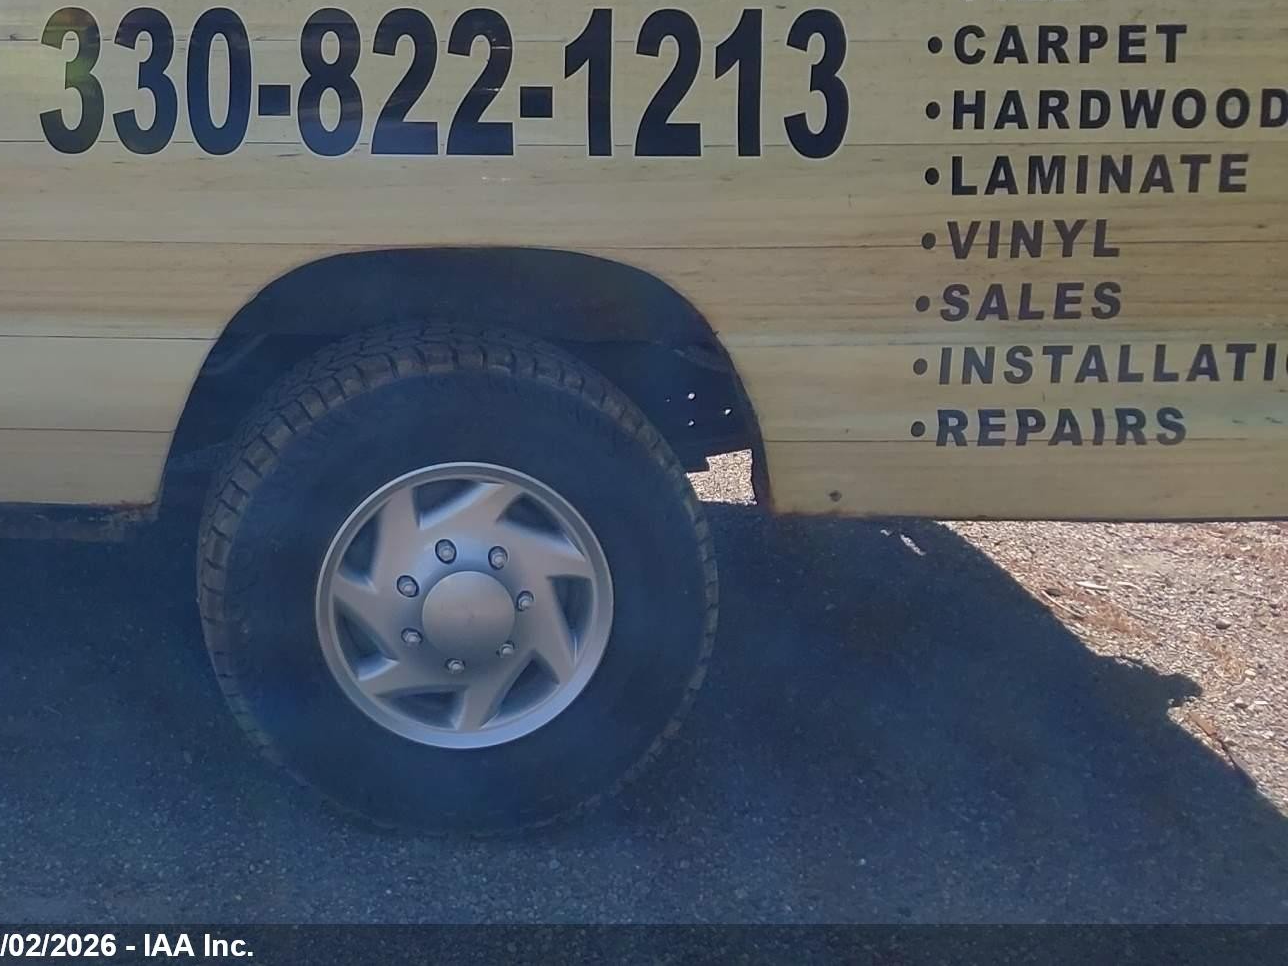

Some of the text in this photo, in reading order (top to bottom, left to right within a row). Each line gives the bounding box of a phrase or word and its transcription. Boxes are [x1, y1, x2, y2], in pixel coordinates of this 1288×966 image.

[954, 24, 1188, 64] CARPET
[39, 7, 849, 158] 330-822-1213
[952, 88, 1288, 130] HARDWOOD
[951, 153, 1250, 196] LAMINATE
[947, 219, 1121, 260] VINYL
[939, 282, 1122, 322] SALES
[938, 343, 1288, 385] INSTALLATI
[935, 407, 1187, 447] REPAIRS
